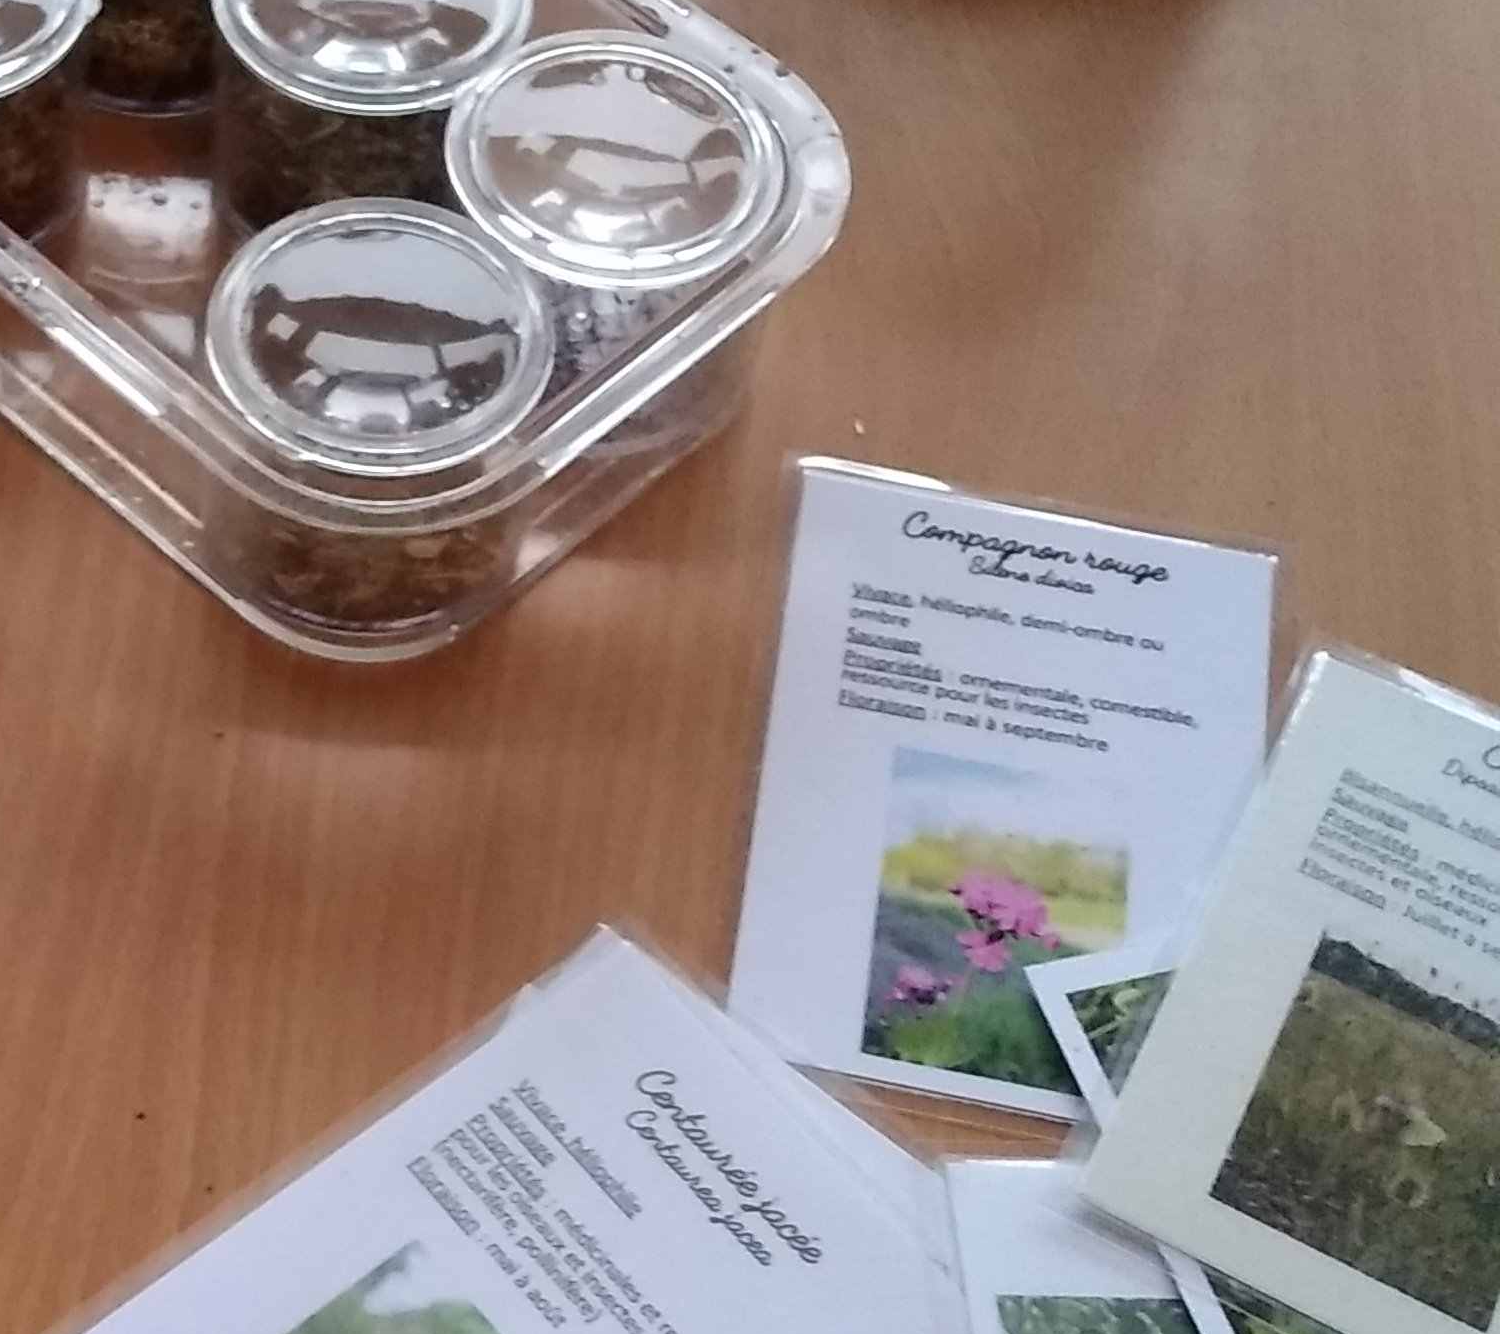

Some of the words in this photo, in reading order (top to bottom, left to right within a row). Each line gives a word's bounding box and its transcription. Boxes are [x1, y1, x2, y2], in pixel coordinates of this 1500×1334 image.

[902, 511, 1077, 572] Compagnon
[1083, 552, 1169, 585] rouge
[849, 607, 911, 628] ombre
[1020, 615, 1135, 647] demi-ombre
[1138, 638, 1164, 651] ou
[841, 669, 931, 695] ressource
[935, 686, 980, 704] pour
[983, 692, 1010, 710] les
[1014, 702, 1089, 725] insectes
[959, 674, 1084, 709] ornementale,
[943, 712, 980, 728] mai
[1002, 723, 1109, 752] septembre
[447, 1128, 493, 1165] pour
[486, 1160, 519, 1191] les
[507, 1191, 567, 1253] oiseaux
[563, 1252, 586, 1273] et
[625, 1110, 722, 1220] Centaurea
[708, 1208, 772, 1266] jacea
[636, 1070, 759, 1198] Centaurée
[739, 1187, 822, 1264] jacée
[484, 1243, 522, 1275] mai
[513, 1275, 530, 1289] à
[525, 1289, 567, 1329] août
[553, 1208, 642, 1304] médicinales
[639, 1303, 662, 1324] et
